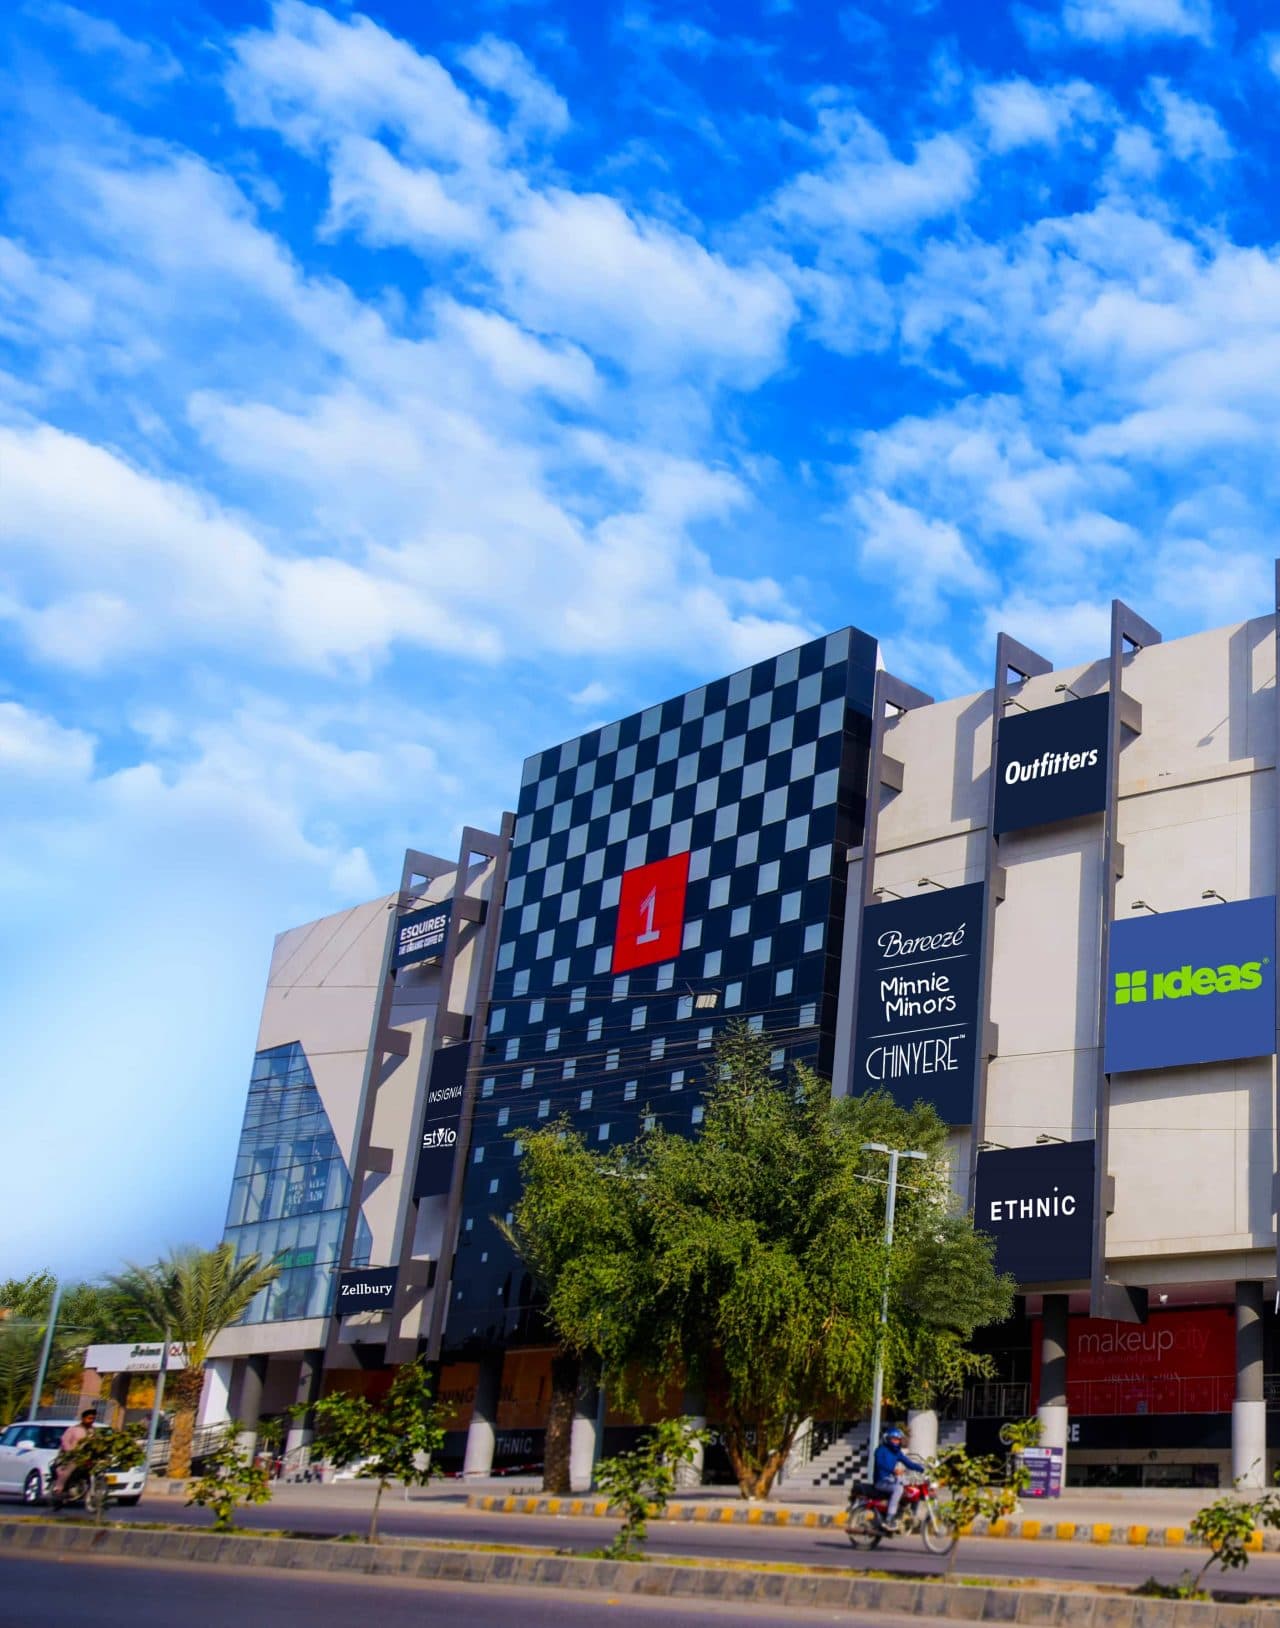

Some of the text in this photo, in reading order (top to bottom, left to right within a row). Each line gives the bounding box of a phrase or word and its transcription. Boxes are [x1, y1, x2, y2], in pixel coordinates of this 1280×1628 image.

[1004, 749, 1098, 785] Outfitters
[400, 914, 447, 941] ESQUIRES
[636, 885, 660, 945] 1
[877, 922, 966, 957] Bareezé
[880, 972, 950, 1002] Minnie
[1152, 961, 1263, 1000] ideas
[885, 995, 956, 1022] Minors
[428, 1085, 463, 1103] INSIGNIA
[423, 1128, 457, 1147] stylo
[341, 1283, 392, 1296] Zellbury
[495, 1431, 533, 1456] THNIC
